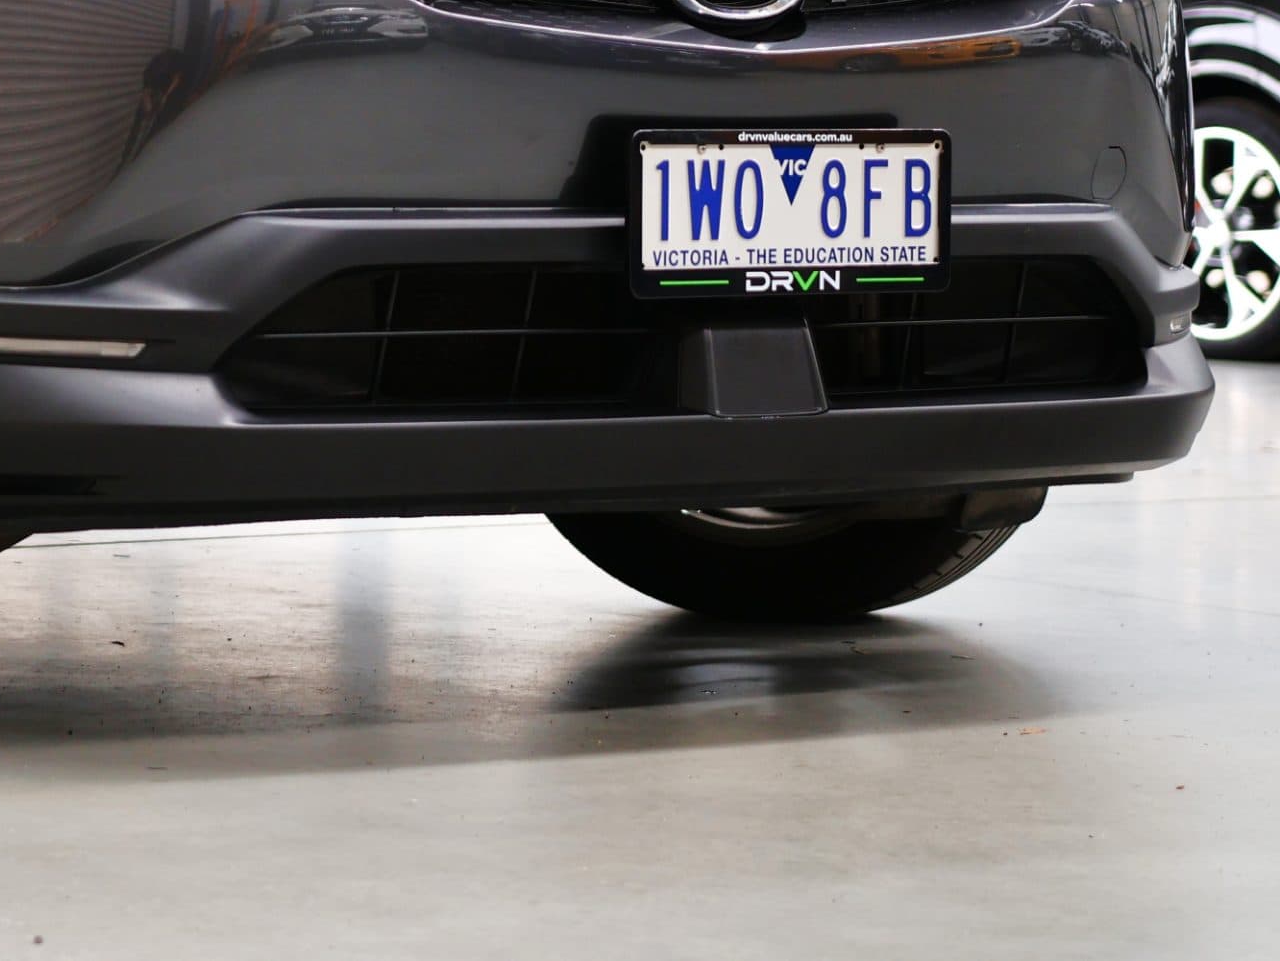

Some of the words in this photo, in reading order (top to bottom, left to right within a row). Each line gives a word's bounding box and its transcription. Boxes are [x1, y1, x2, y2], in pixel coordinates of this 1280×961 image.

[738, 131, 853, 142] drvnvaluecars.com.au
[774, 158, 807, 176] VIC
[820, 158, 932, 239] 8FB
[653, 250, 729, 266] VICTORIA
[747, 248, 778, 265] THE
[784, 247, 874, 264] EDUCATION
[880, 245, 927, 262] STATE
[745, 271, 841, 292] DRVN
